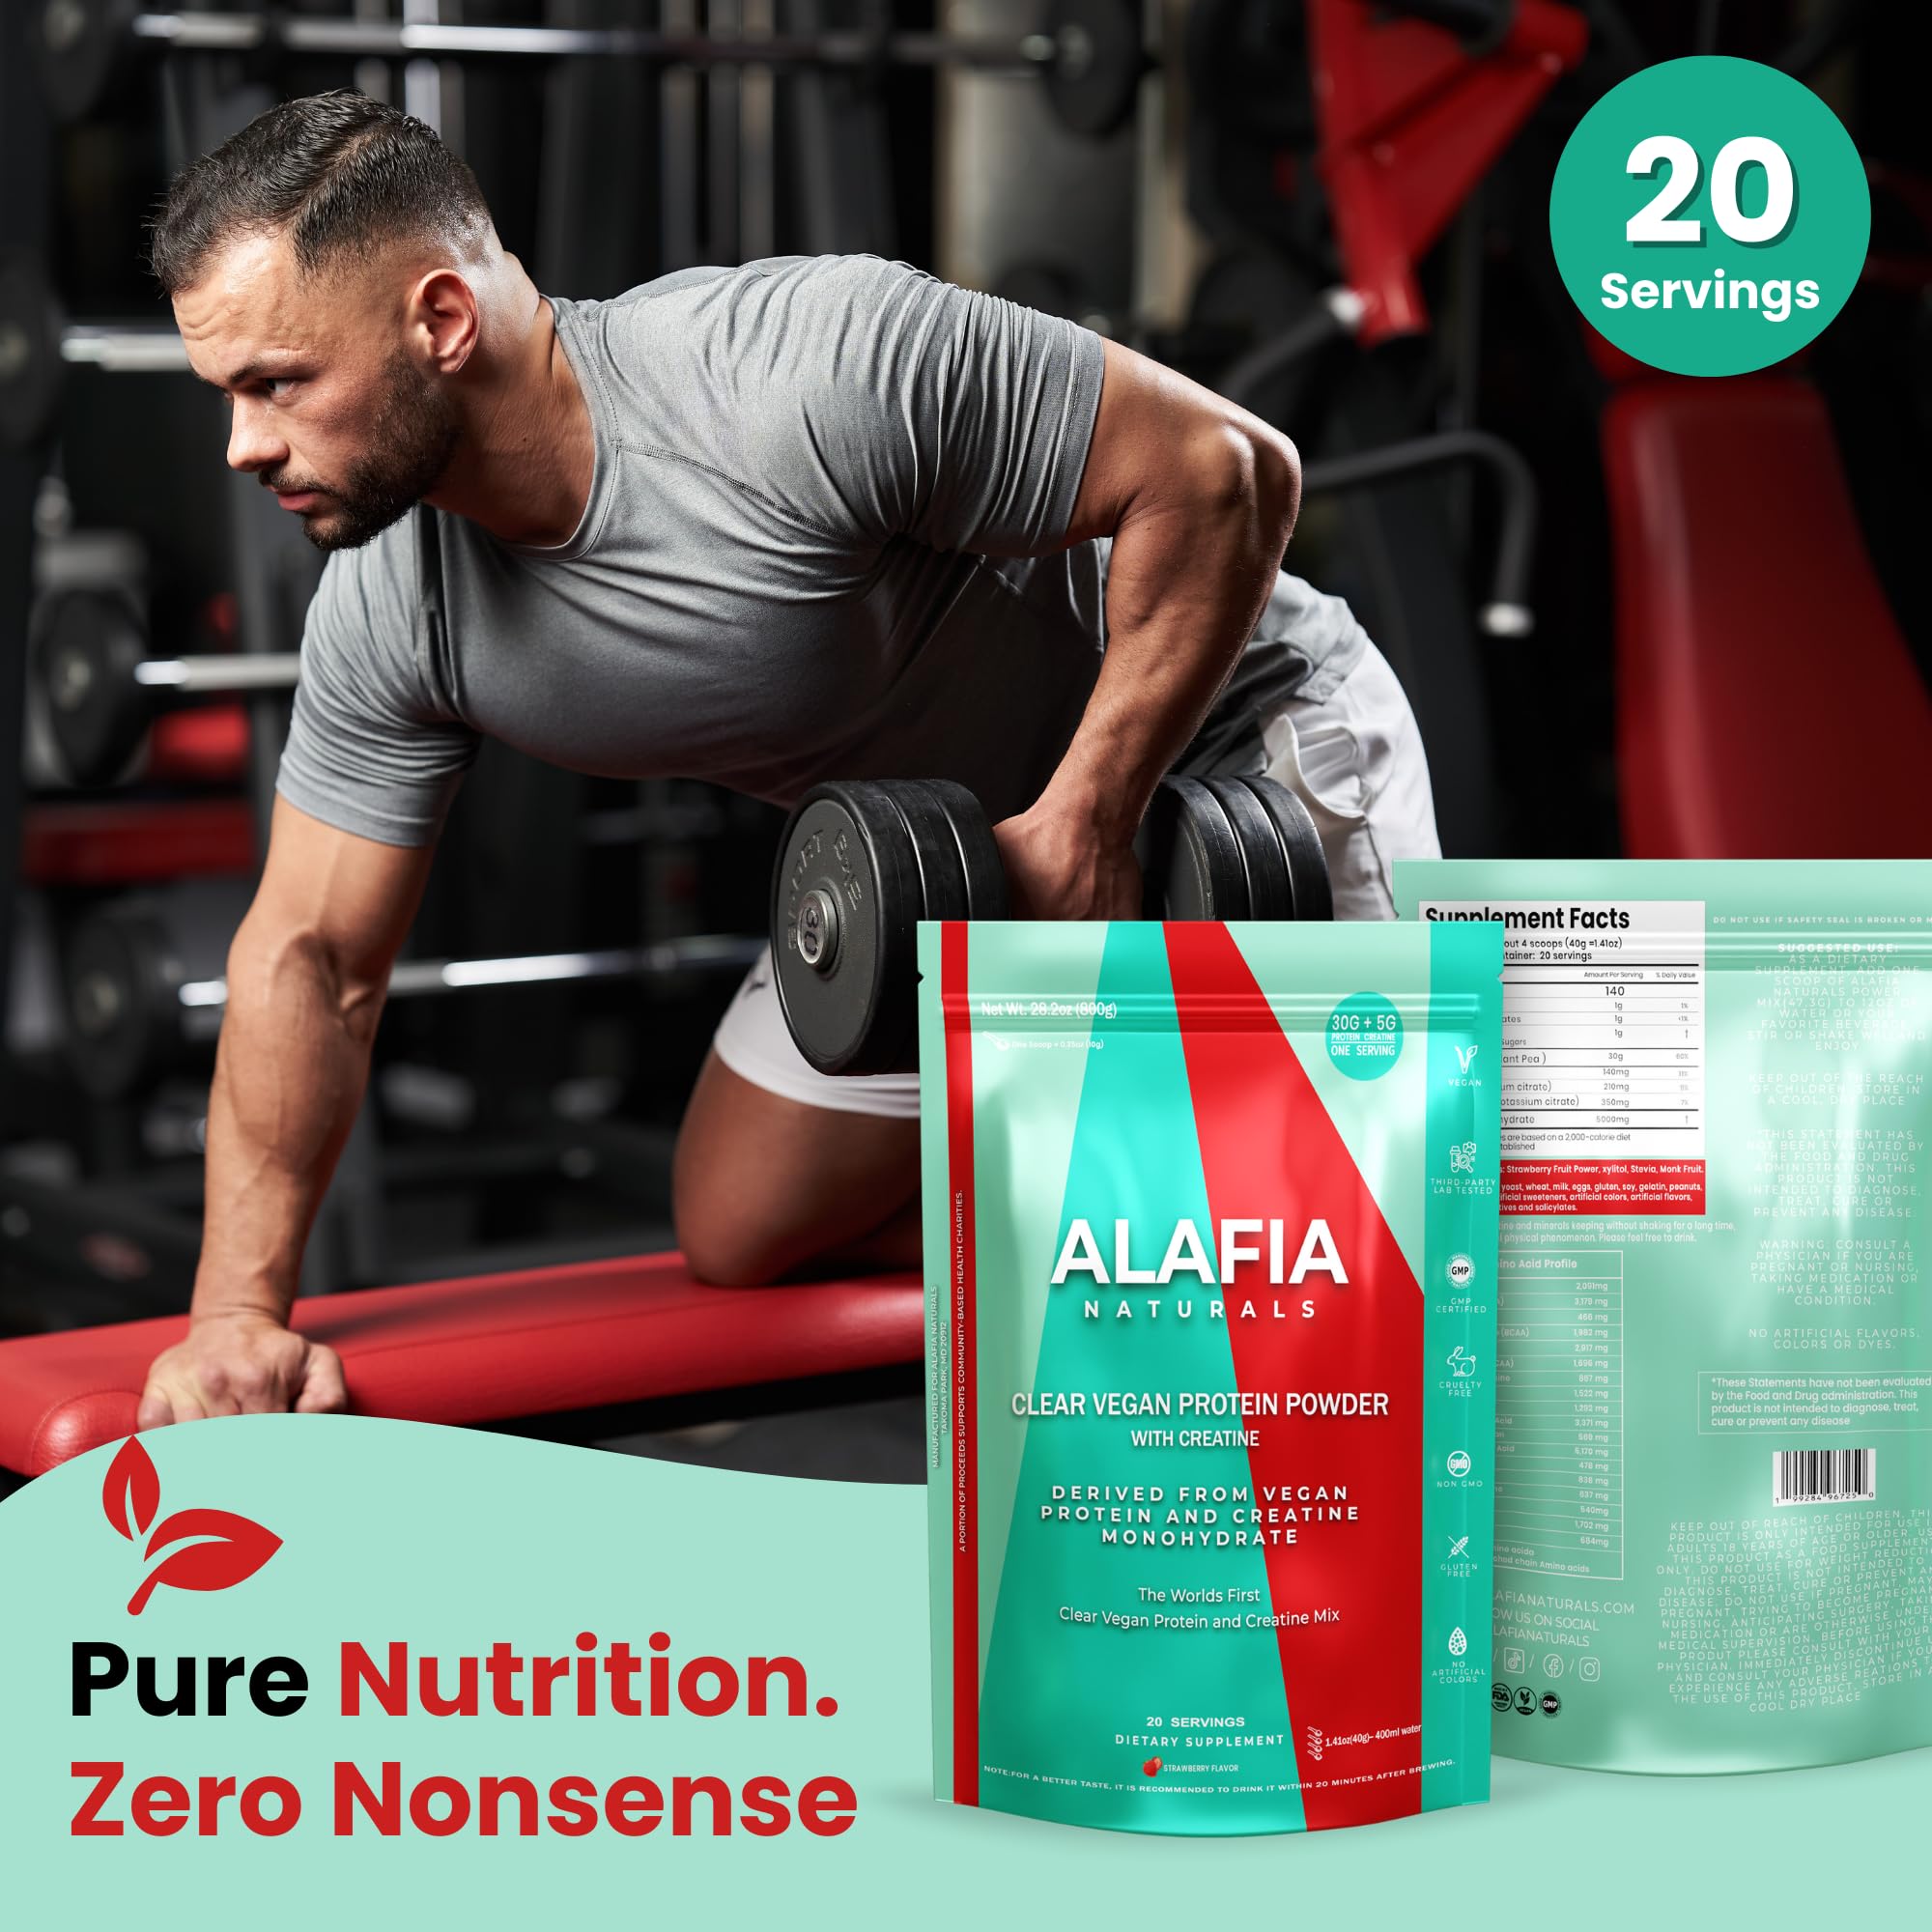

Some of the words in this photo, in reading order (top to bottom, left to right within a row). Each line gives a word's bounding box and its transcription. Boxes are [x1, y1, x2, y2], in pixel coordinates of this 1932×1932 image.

[1570, 907, 1630, 929] Facts
[1530, 940, 1562, 950] scoops
[1565, 937, 1586, 950] (40g
[1589, 937, 1622, 950] =1.41oz)
[1553, 952, 1592, 962] servings
[1605, 986, 1625, 996] 140
[981, 1003, 1003, 1015] Net
[1006, 1003, 1027, 1015] Wt.
[1031, 1003, 1072, 1015] 28.2oz
[1076, 1003, 1117, 1018] (800g)
[1332, 1015, 1359, 1031] 30G
[1364, 1018, 1372, 1028] +
[1377, 1015, 1396, 1031] 5G
[1332, 1033, 1360, 1041] PROTEIN
[1364, 1033, 1396, 1041] CREATINE
[1086, 1039, 1103, 1049] (10g)
[1331, 1045, 1350, 1056] ONE
[1356, 1045, 1395, 1056] SERVING
[1608, 1052, 1624, 1062] 30g
[1603, 1067, 1630, 1077] 140mg
[1604, 1083, 1630, 1092] 210mg
[1601, 1098, 1630, 1107] 350mg
[1596, 1115, 1630, 1124] 5000mg
[1507, 1165, 1551, 1175] Strawberry
[1574, 1165, 1600, 1175] Power,
[1603, 1165, 1629, 1175] xylitol,
[1631, 1165, 1658, 1175] Stevia,
[1501, 1183, 1523, 1193] yeast,
[1525, 1182, 1549, 1191] wheat,
[1553, 1182, 1570, 1191] milk,
[1572, 1184, 1592, 1193] eggs,
[1595, 1182, 1620, 1193] gluten,
[1623, 1184, 1637, 1193] soy,
[1639, 1182, 1666, 1193] gelatin,
[1050, 1218, 1350, 1284] ALAFIA
[1452, 1266, 1468, 1275] GMP
[1519, 1260, 1541, 1268] Acid
[1545, 1260, 1577, 1268] Profile
[1085, 1299, 1315, 1318] NATURALS
[941, 1349, 947, 1364] MD
[1748, 1378, 1806, 1387] Statements
[1809, 1378, 1834, 1387] have
[1837, 1378, 1853, 1387] not
[1856, 1378, 1880, 1387] been
[1883, 1377, 1931, 1386] evaluated
[1712, 1391, 1723, 1403] by
[1726, 1391, 1743, 1400] the
[1745, 1391, 1770, 1400] Food
[1773, 1391, 1792, 1400] and
[1795, 1391, 1818, 1403] Drug
[1821, 1390, 1896, 1401] administration.
[1898, 1390, 1918, 1399] This
[1011, 1393, 1085, 1415] CLEAR
[1093, 1393, 1172, 1415] VEGAN
[1179, 1393, 1278, 1415] PROTEIN
[1286, 1393, 1389, 1415] POWDER
[1131, 1430, 1174, 1446] WITH
[1179, 1430, 1260, 1447] CREATINE
[1450, 1460, 1467, 1469] GMO
[959, 1491, 965, 1502] OF
[1052, 1485, 1164, 1502] DERIVED
[1179, 1487, 1248, 1502] FROM
[1263, 1486, 1348, 1501] VEGAN
[1040, 1506, 1151, 1523] PROTEIN
[1166, 1508, 1218, 1524] AND
[1233, 1507, 1359, 1523] CREATINE
[1102, 1528, 1298, 1546] MONOHYDRATE
[1138, 1587, 1166, 1602] The
[1171, 1588, 1223, 1603] Worlds
[1227, 1587, 1260, 1602] First
[1059, 1606, 1097, 1624] Clear
[1102, 1611, 1150, 1630] Vegan
[1154, 1614, 1208, 1629] Protein
[1212, 1613, 1241, 1629] and
[1245, 1611, 1309, 1628] Creatine
[1314, 1607, 1340, 1624] Mix
[1516, 1610, 1530, 1624] US
[1534, 1614, 1552, 1626] ON
[1555, 1617, 1600, 1631] SOCIAL
[1749, 1703, 1784, 1713] COOL
[1790, 1699, 1815, 1710] DRY
[1821, 1691, 1861, 1706] PLACE
[1146, 1717, 1163, 1727] 20
[1171, 1717, 1245, 1727] SERVINGS
[1376, 1728, 1400, 1739] 400ml
[1401, 1724, 1421, 1736] water
[1116, 1734, 1179, 1747] DIETARY
[1186, 1735, 1284, 1747] SUPPLEMENT
[983, 1765, 1030, 1779] NOTE:FOR
[1042, 1776, 1077, 1785] BETTER
[1278, 1782, 1312, 1791] WITHIN
[1331, 1776, 1374, 1785] MINUTES
[1377, 1770, 1406, 1779] AFTER
[1408, 1759, 1456, 1775] BREWING.
